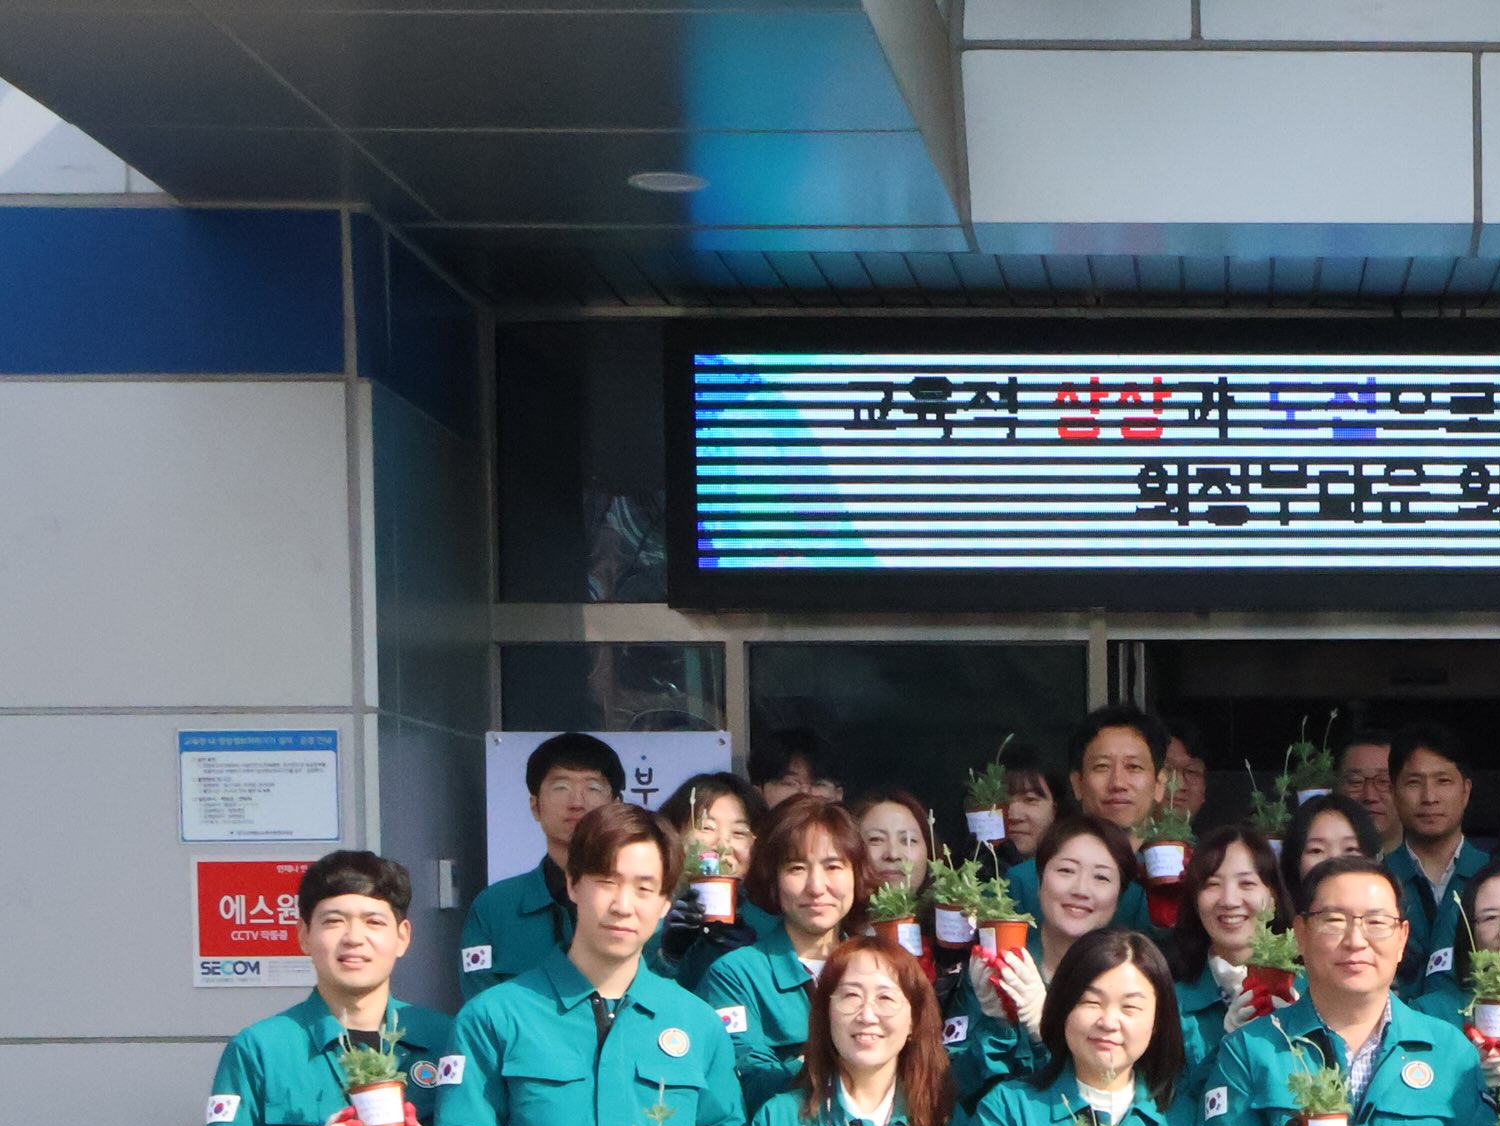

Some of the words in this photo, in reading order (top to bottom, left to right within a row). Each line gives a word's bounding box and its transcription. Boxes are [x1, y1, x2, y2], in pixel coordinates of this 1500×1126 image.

[1052, 376, 1235, 439] 상상과
[218, 894, 300, 925] 에스원
[230, 930, 259, 941] CCTV
[201, 960, 261, 976] SECOM
